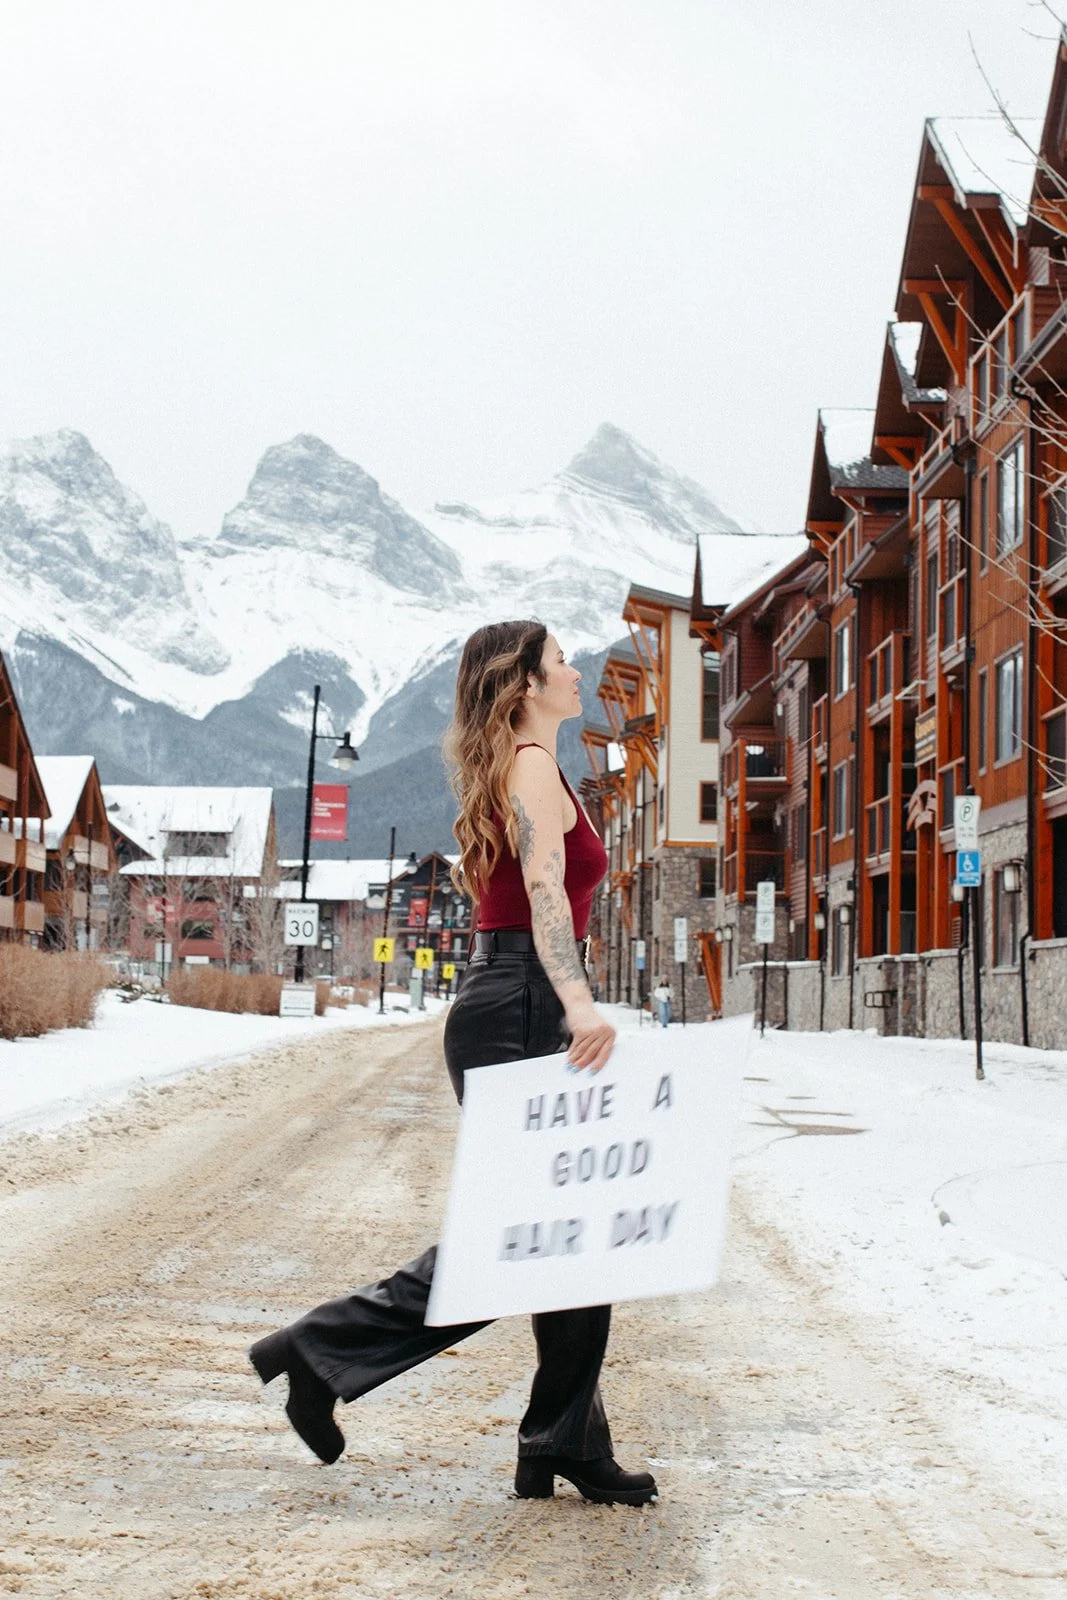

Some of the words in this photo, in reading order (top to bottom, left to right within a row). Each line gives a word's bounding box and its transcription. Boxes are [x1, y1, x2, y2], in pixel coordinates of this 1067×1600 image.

[289, 920, 314, 938] 30
[523, 1083, 617, 1131] HAVE
[652, 1073, 673, 1111] A
[552, 1139, 650, 1187] GOOD
[499, 1217, 583, 1262] HAIR
[610, 1201, 679, 1249] DAY
